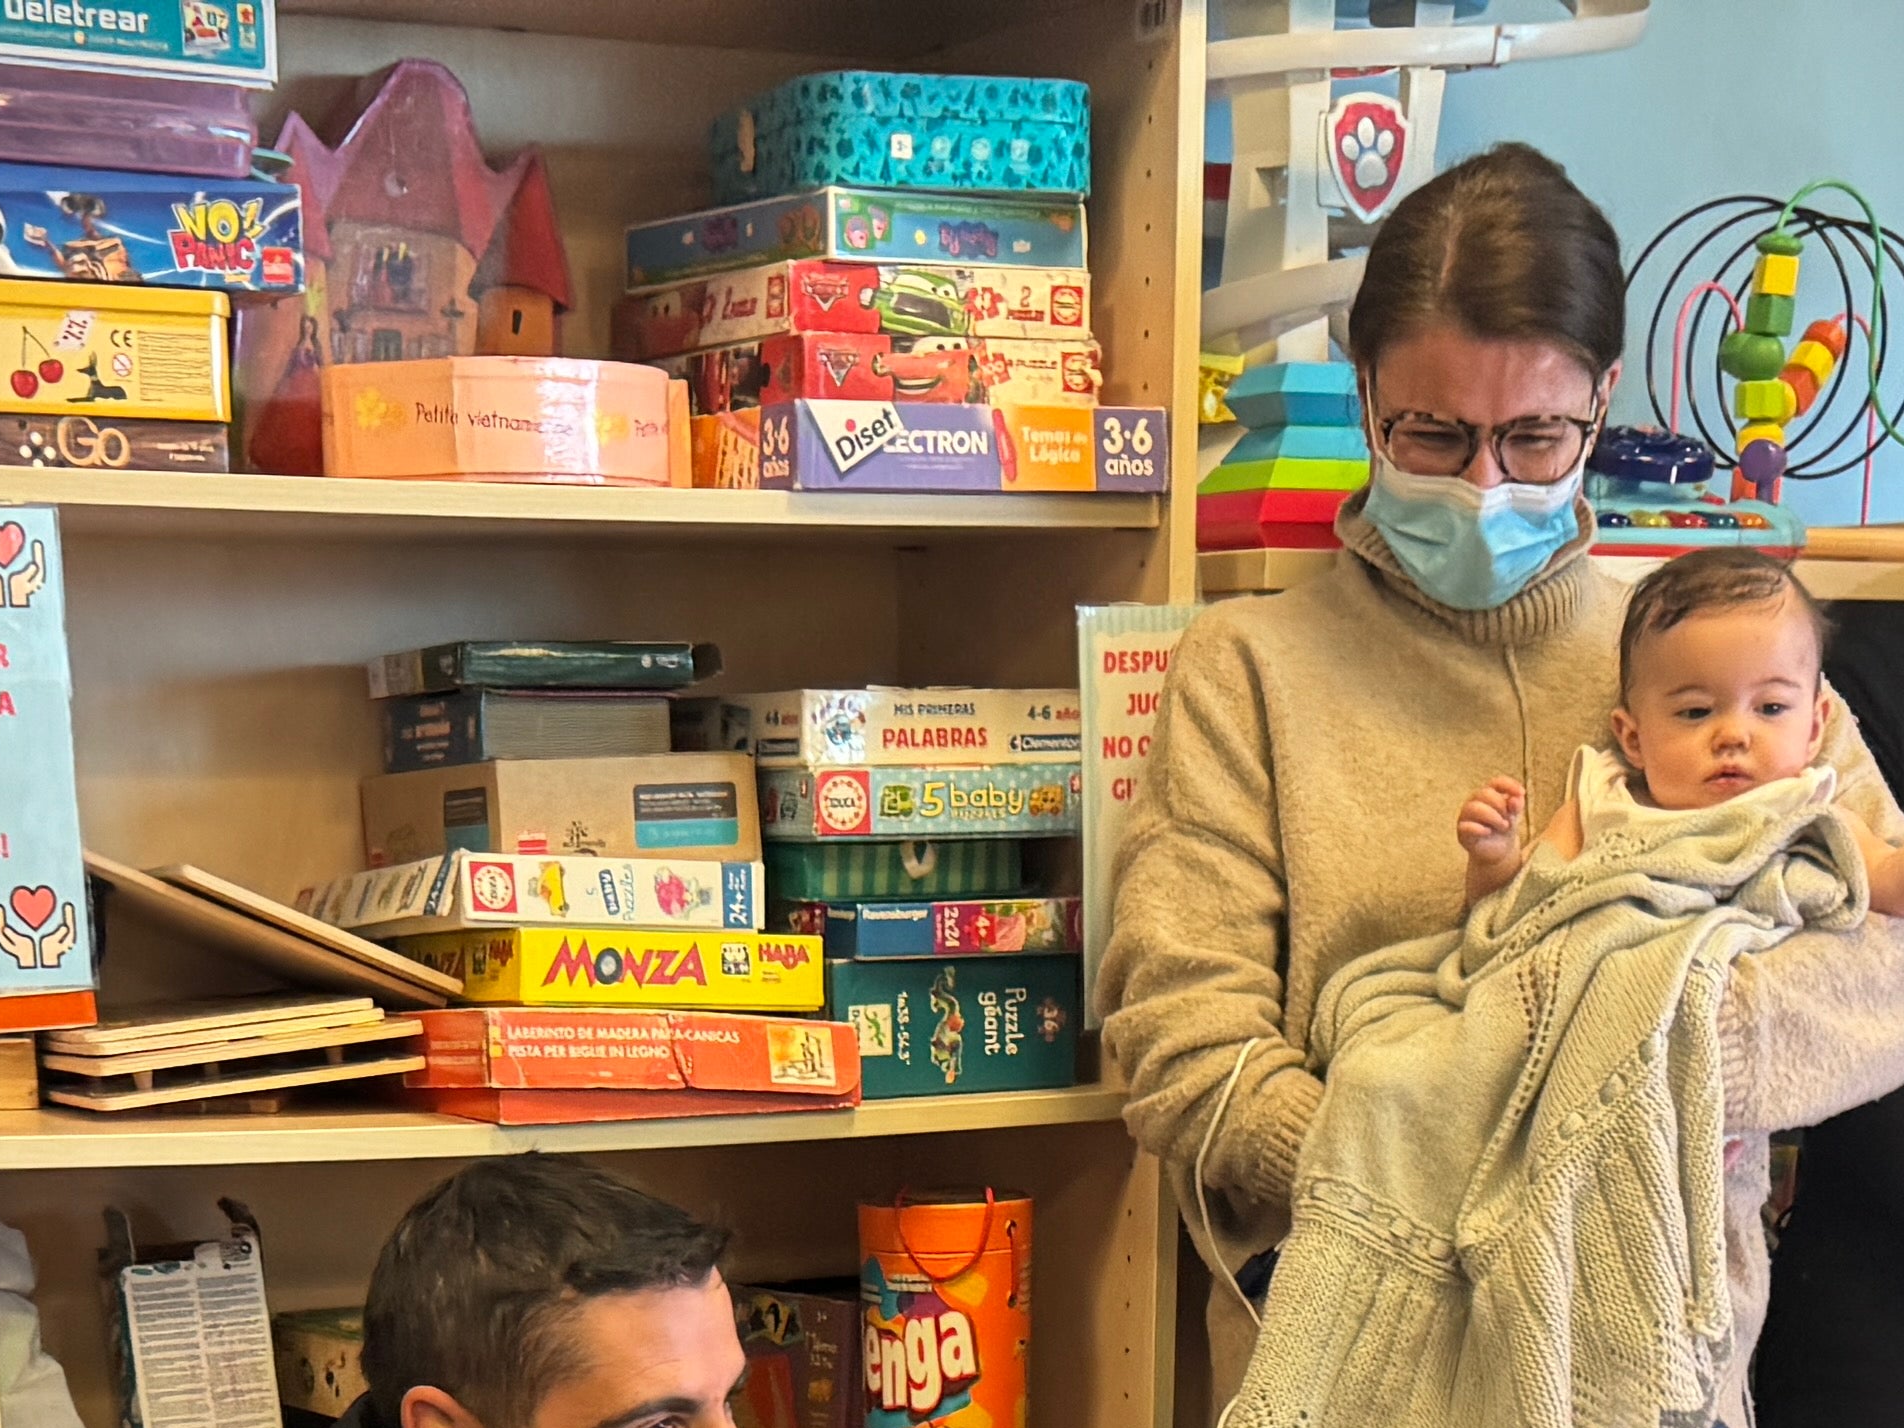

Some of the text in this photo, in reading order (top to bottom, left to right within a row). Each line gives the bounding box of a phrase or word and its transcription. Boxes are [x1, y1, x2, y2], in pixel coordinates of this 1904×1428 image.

[173, 197, 268, 244] NO!
[170, 231, 255, 270] PANIC
[56, 416, 132, 467] Go
[835, 407, 898, 462] Diset
[1104, 453, 1154, 477] años
[1103, 650, 1173, 674] DESPU
[894, 702, 976, 716] MIS PRIMERAS
[882, 727, 989, 750] PALABRAS
[1103, 735, 1133, 759] NO
[919, 782, 946, 817] 5
[949, 783, 1024, 816] baby
[1111, 778, 1138, 801] GI
[541, 936, 708, 989] MONZA
[757, 942, 809, 969] HABA
[977, 991, 1000, 1057] géant
[1004, 986, 1027, 1057] Puzzle
